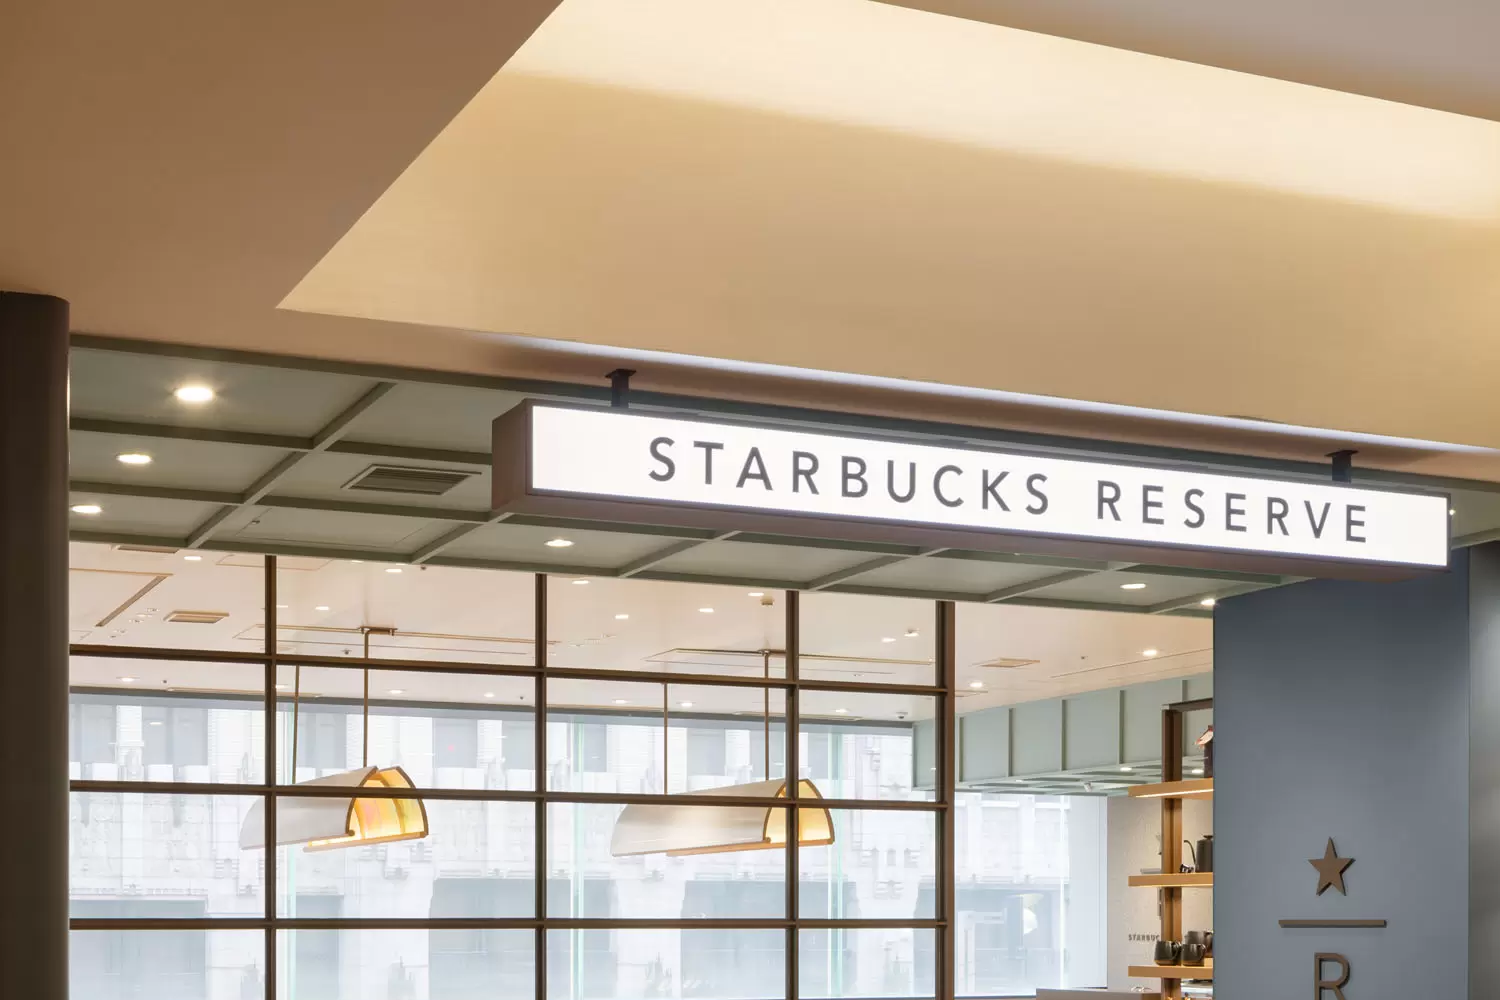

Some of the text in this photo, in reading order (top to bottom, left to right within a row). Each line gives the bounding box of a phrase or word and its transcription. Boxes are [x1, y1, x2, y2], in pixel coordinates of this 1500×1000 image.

[648, 437, 1367, 544] STARBUCKS RESERVE
[1128, 933, 1160, 942] STARBUC
